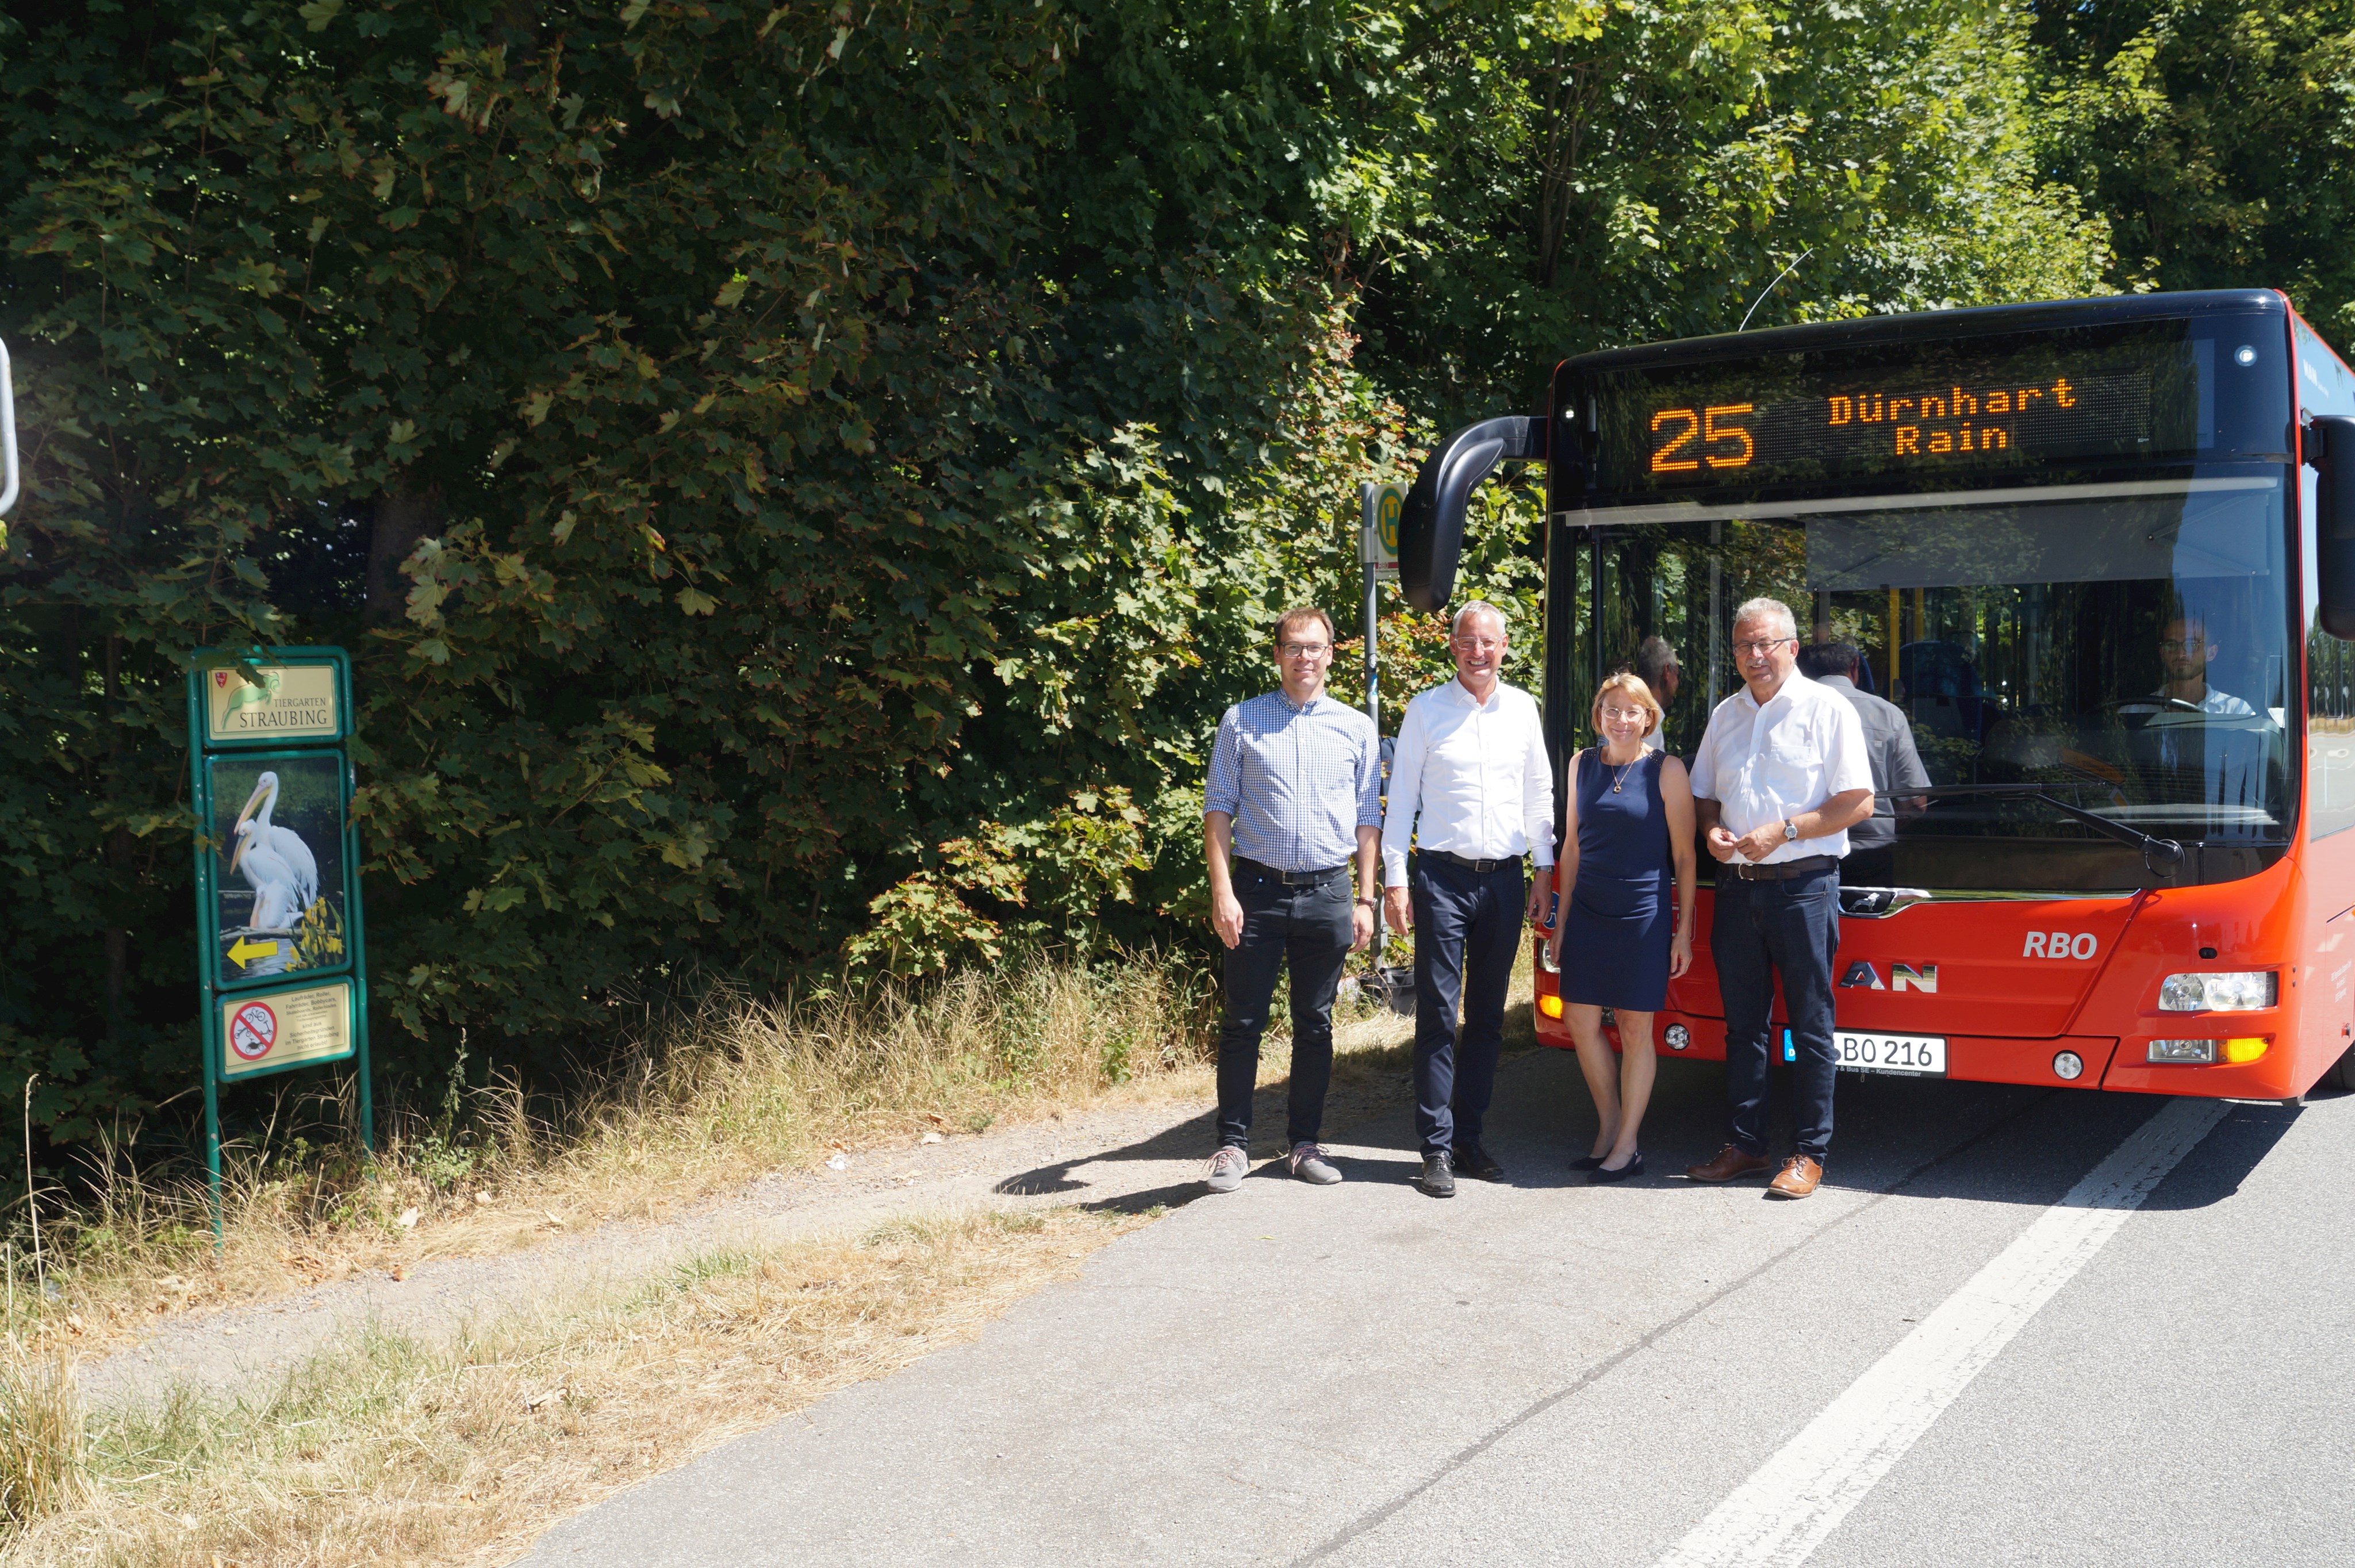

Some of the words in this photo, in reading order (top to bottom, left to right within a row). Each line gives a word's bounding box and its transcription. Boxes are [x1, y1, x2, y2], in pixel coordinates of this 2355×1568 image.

[1828, 378, 2075, 425] Dürnhart
[1651, 404, 1753, 471] 25
[1896, 421, 2006, 455] Rain
[1384, 503, 1399, 540] H
[273, 697, 326, 707] TIERGARTEN
[240, 710, 327, 728] STRAUBING
[2022, 931, 2097, 960] RBO
[1839, 961, 1937, 994] AN
[292, 1036, 316, 1044] Tiergarten
[1884, 1040, 1932, 1067] 216
[1876, 1068, 1921, 1078] Kundencenter
